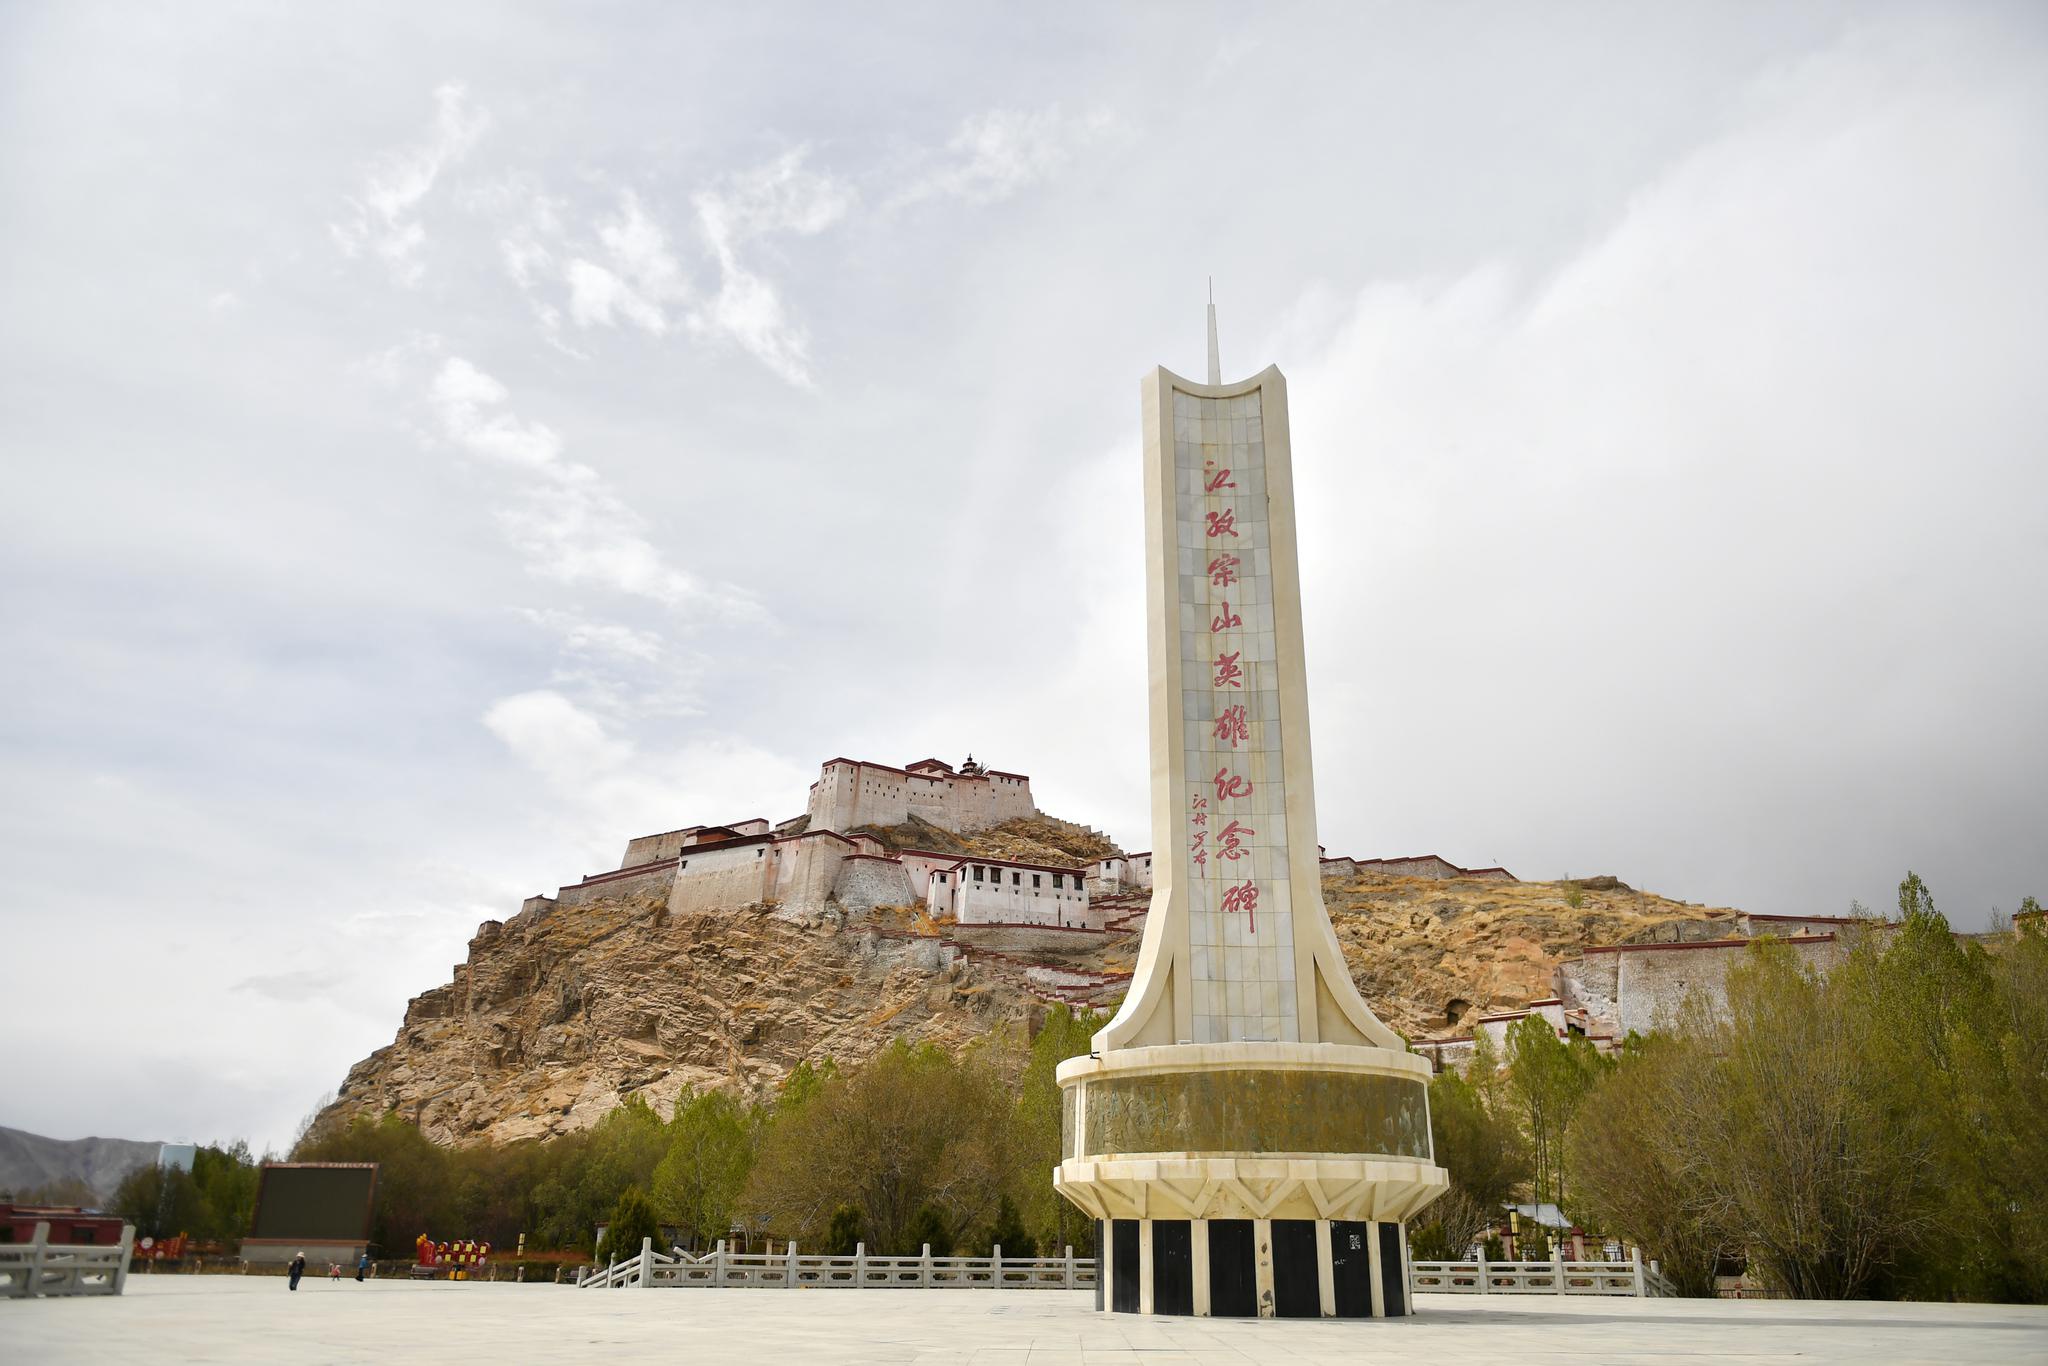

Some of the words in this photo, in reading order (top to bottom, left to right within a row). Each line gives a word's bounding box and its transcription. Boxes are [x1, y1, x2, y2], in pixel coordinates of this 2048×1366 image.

[1204, 461, 1260, 934] 江孜宗山英雄纪念碑
